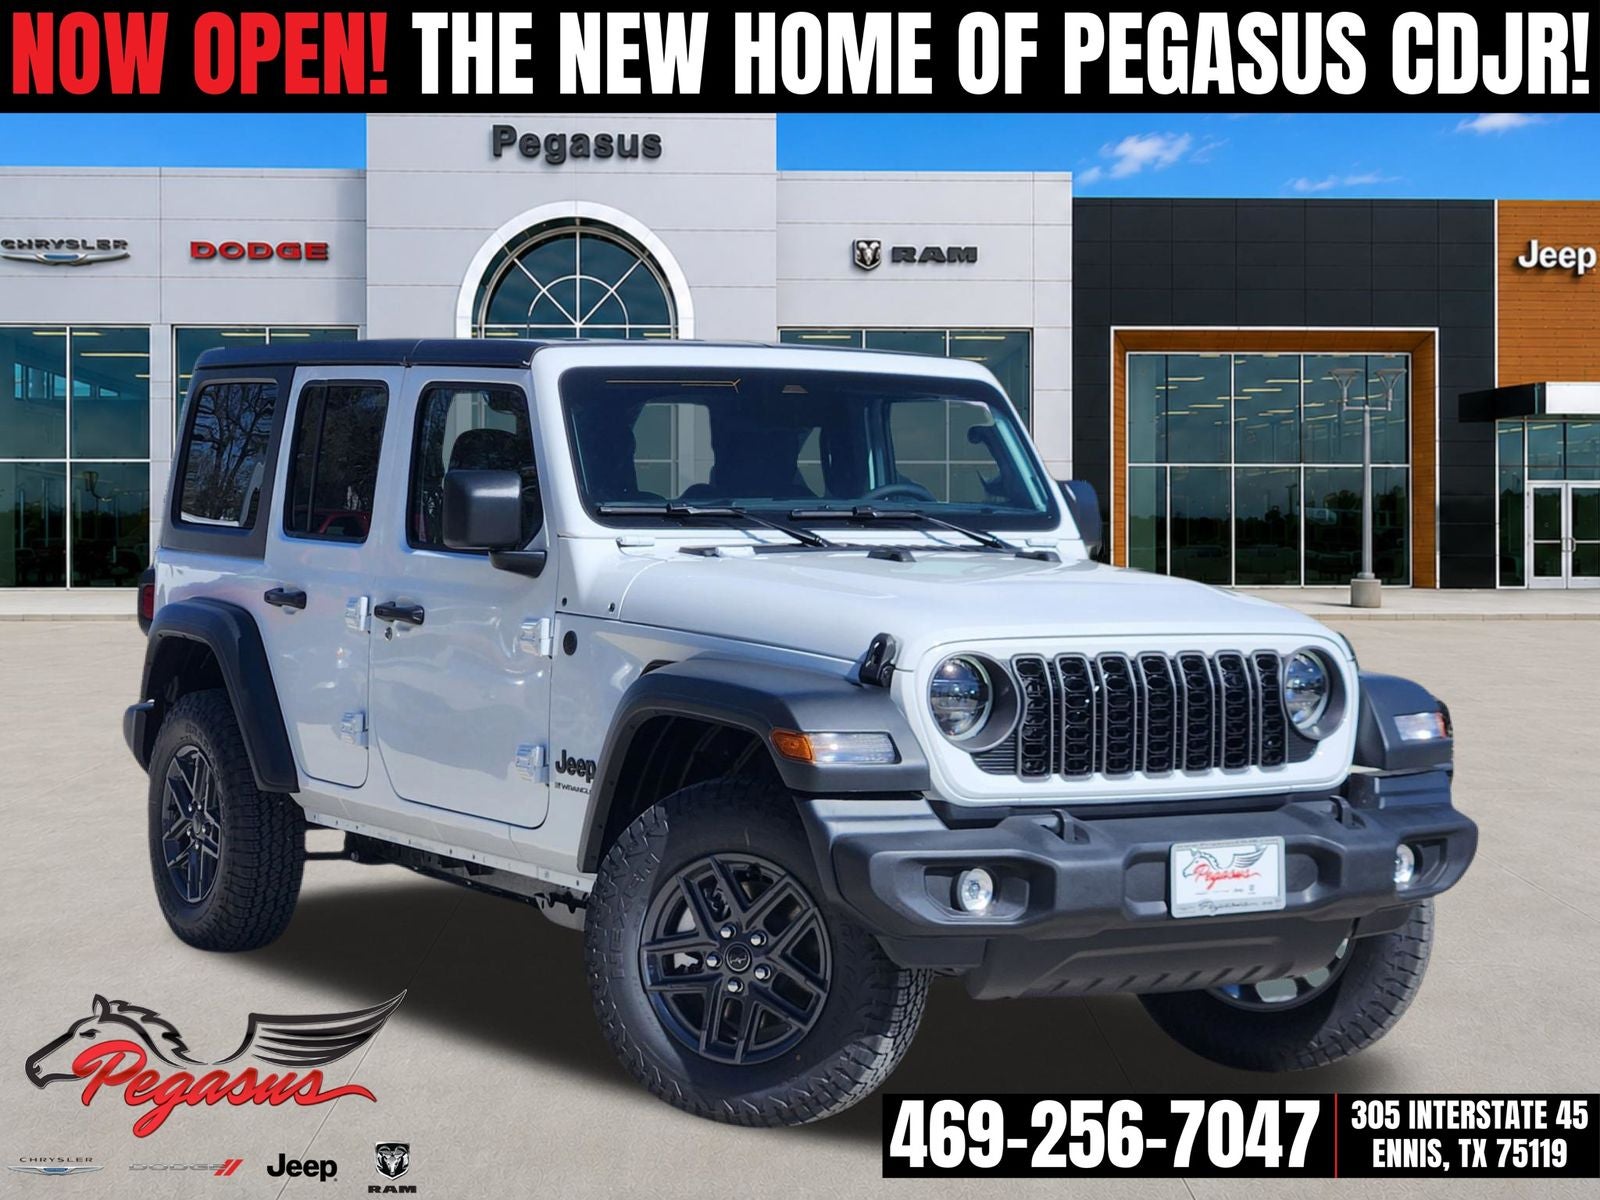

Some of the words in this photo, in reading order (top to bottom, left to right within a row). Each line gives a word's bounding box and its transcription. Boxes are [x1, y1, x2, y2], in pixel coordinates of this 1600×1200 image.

[492, 124, 662, 166] Pegasus
[0, 238, 129, 251] CHRYSLER
[190, 241, 328, 260] DODGE
[890, 246, 978, 263] RAM
[1518, 239, 1597, 275] Jeep
[555, 749, 597, 783] Jeep
[562, 783, 592, 796] WRANGL
